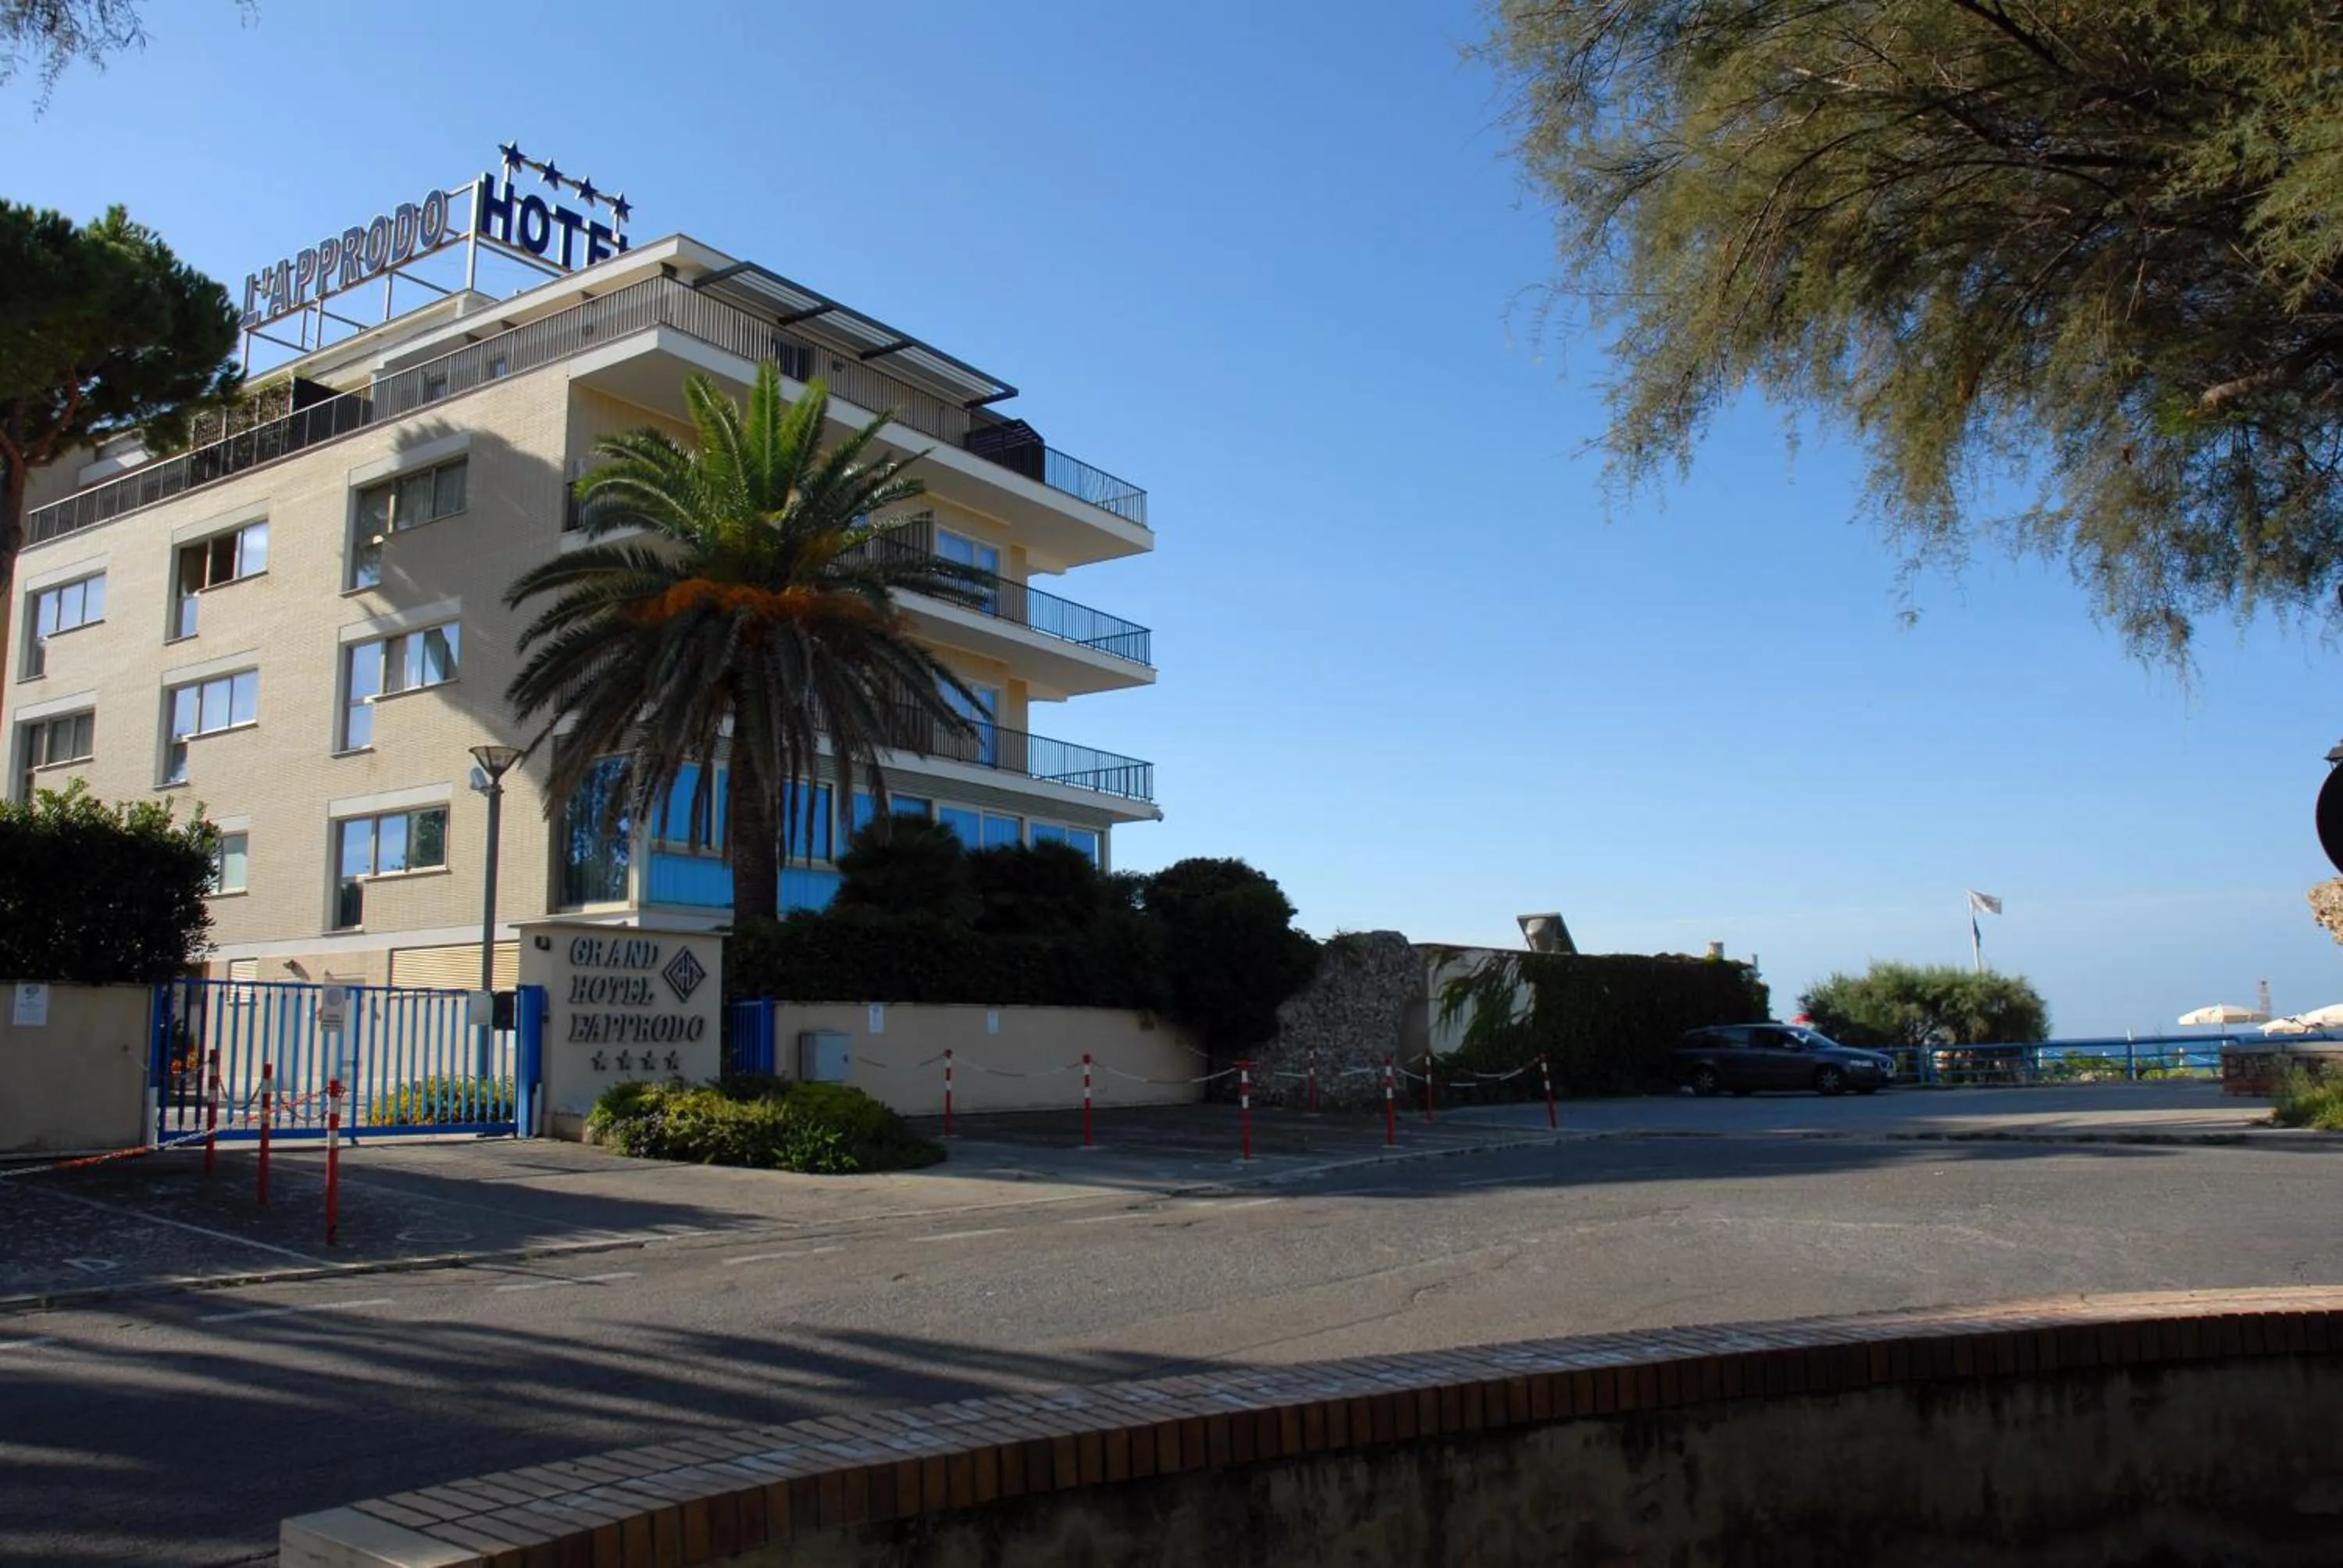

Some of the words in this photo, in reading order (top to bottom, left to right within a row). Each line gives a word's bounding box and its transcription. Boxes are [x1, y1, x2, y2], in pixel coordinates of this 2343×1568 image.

[241, 189, 449, 326] L'APPRODO
[569, 936, 659, 969] GRAND
[568, 975, 654, 1005] HOTEL
